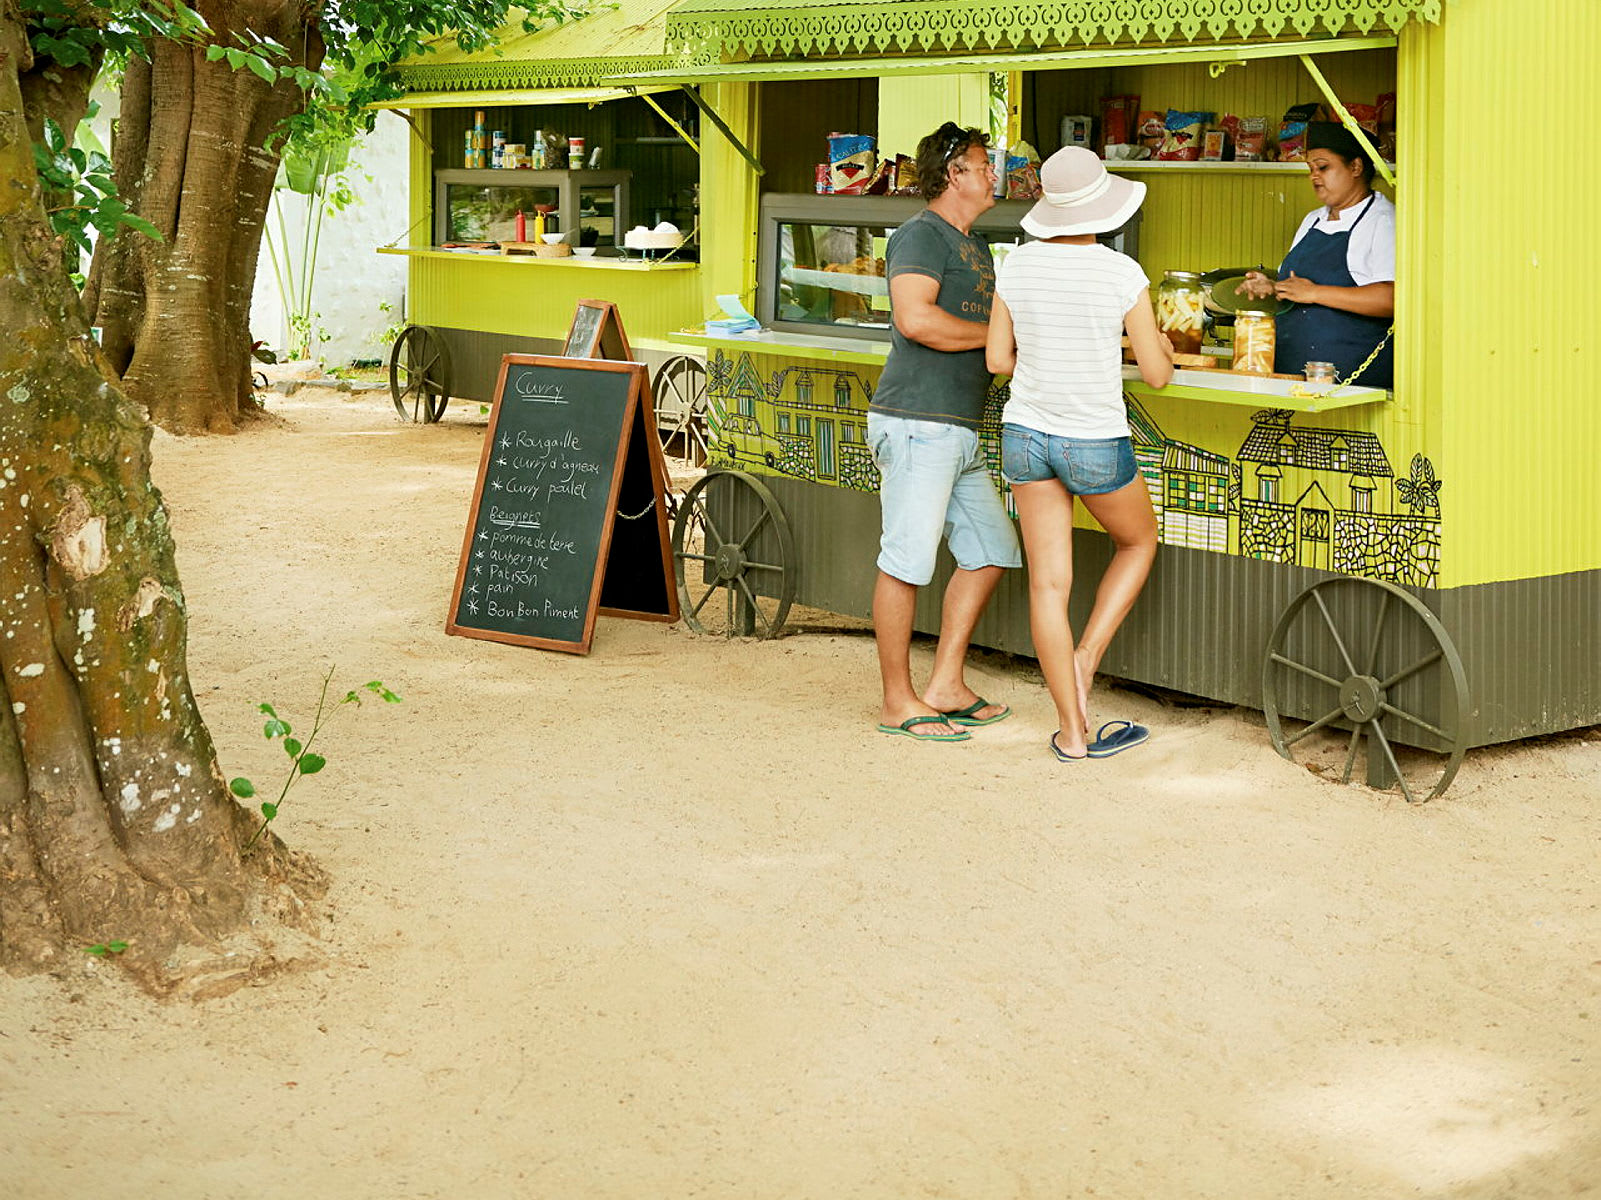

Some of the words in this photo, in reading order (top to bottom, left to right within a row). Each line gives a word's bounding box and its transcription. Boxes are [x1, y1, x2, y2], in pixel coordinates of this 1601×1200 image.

[515, 371, 564, 404] Curry
[505, 477, 540, 501] Curry
[547, 481, 587, 503] poulet
[549, 531, 576, 554] terre
[489, 549, 549, 573] aubergine
[485, 584, 514, 601] pain
[487, 601, 515, 617] Bon
[517, 601, 539, 617] Bon
[543, 599, 579, 619] Piment
